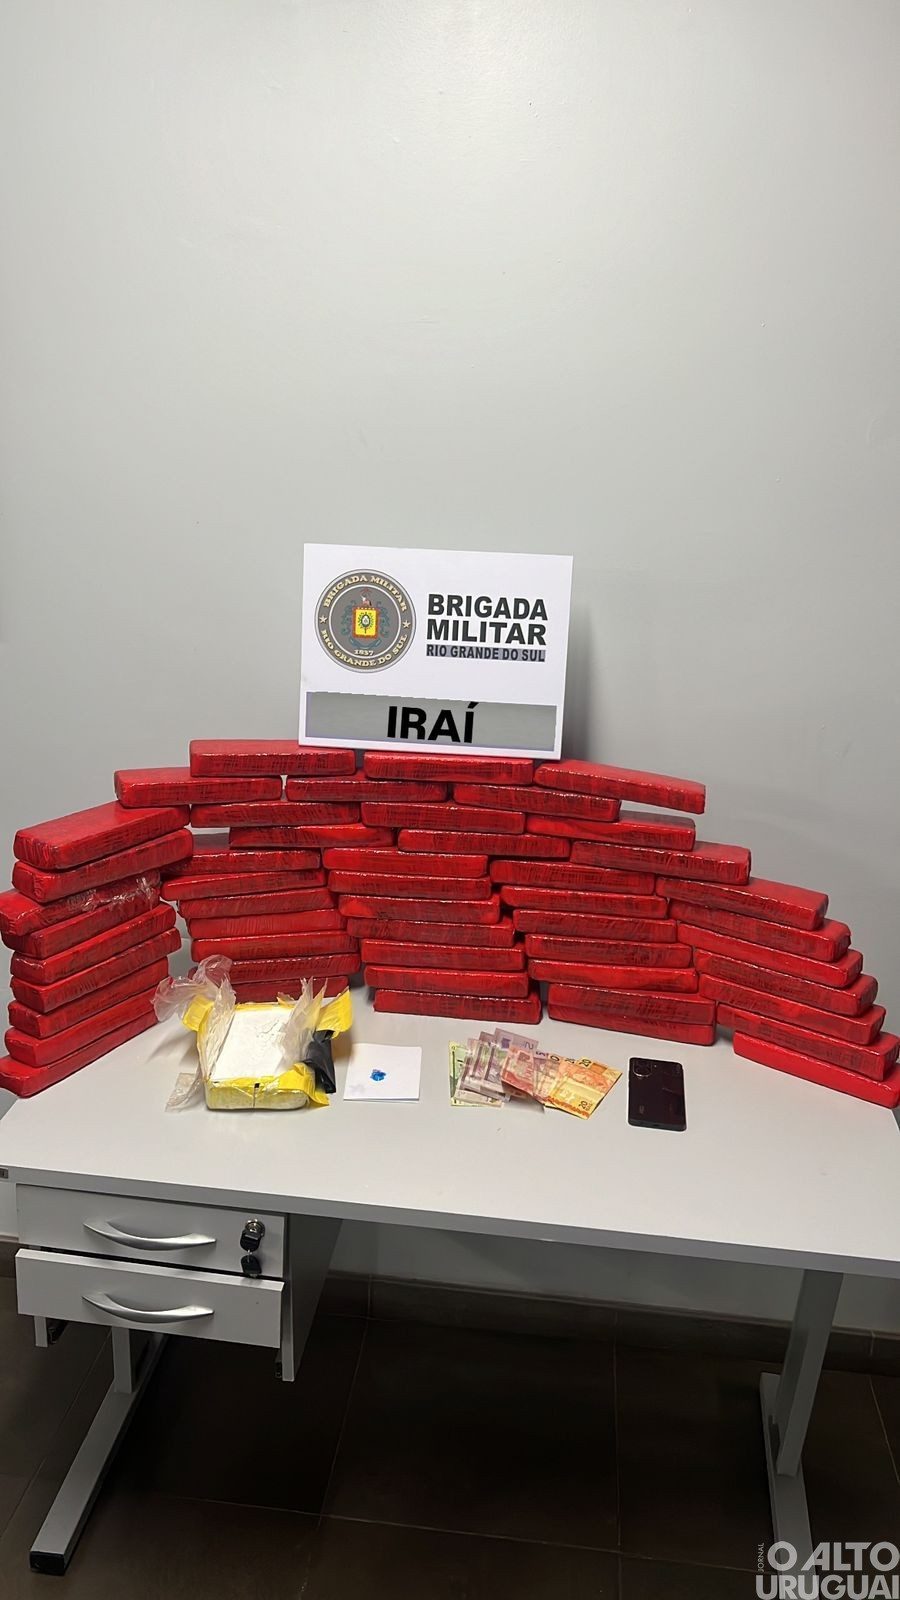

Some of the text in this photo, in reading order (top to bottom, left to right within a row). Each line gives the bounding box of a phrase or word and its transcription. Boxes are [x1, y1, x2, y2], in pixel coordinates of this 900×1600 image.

[323, 575, 408, 612] BRIGADA MILITAR
[427, 593, 549, 621] BRIGADA
[426, 618, 547, 646] MILITAR
[321, 629, 408, 667] RIO GRANDE DO SUL
[426, 644, 546, 662] RIO GRANDE DO SUL
[386, 702, 480, 744] IRAÍ
[578, 1100, 588, 1109] 20
